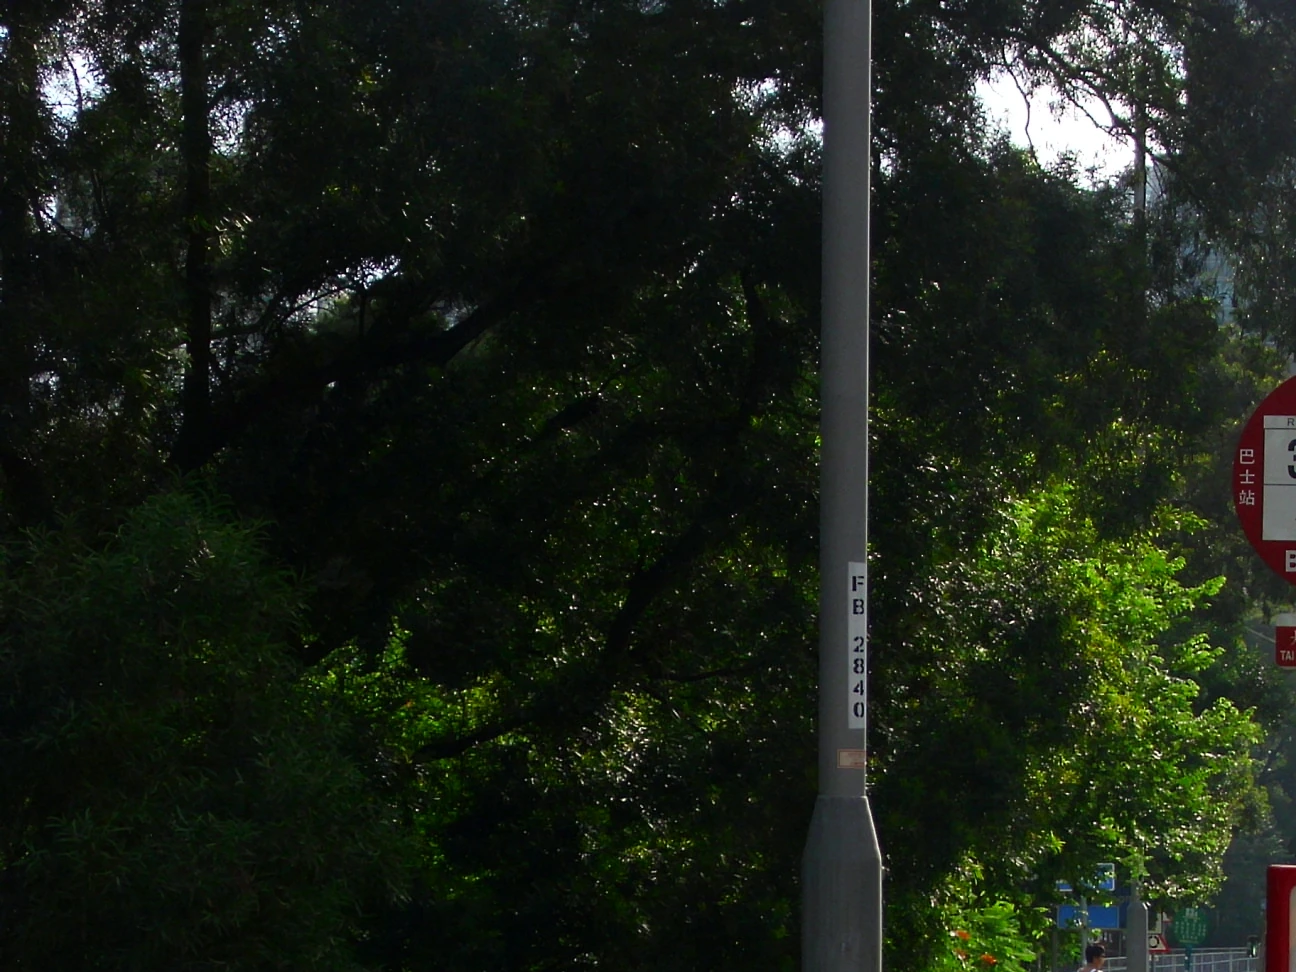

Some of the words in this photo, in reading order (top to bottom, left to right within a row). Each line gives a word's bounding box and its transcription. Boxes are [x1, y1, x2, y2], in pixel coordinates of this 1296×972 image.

[1238, 448, 1255, 506] 巴士站
[1280, 650, 1295, 661] TAI
